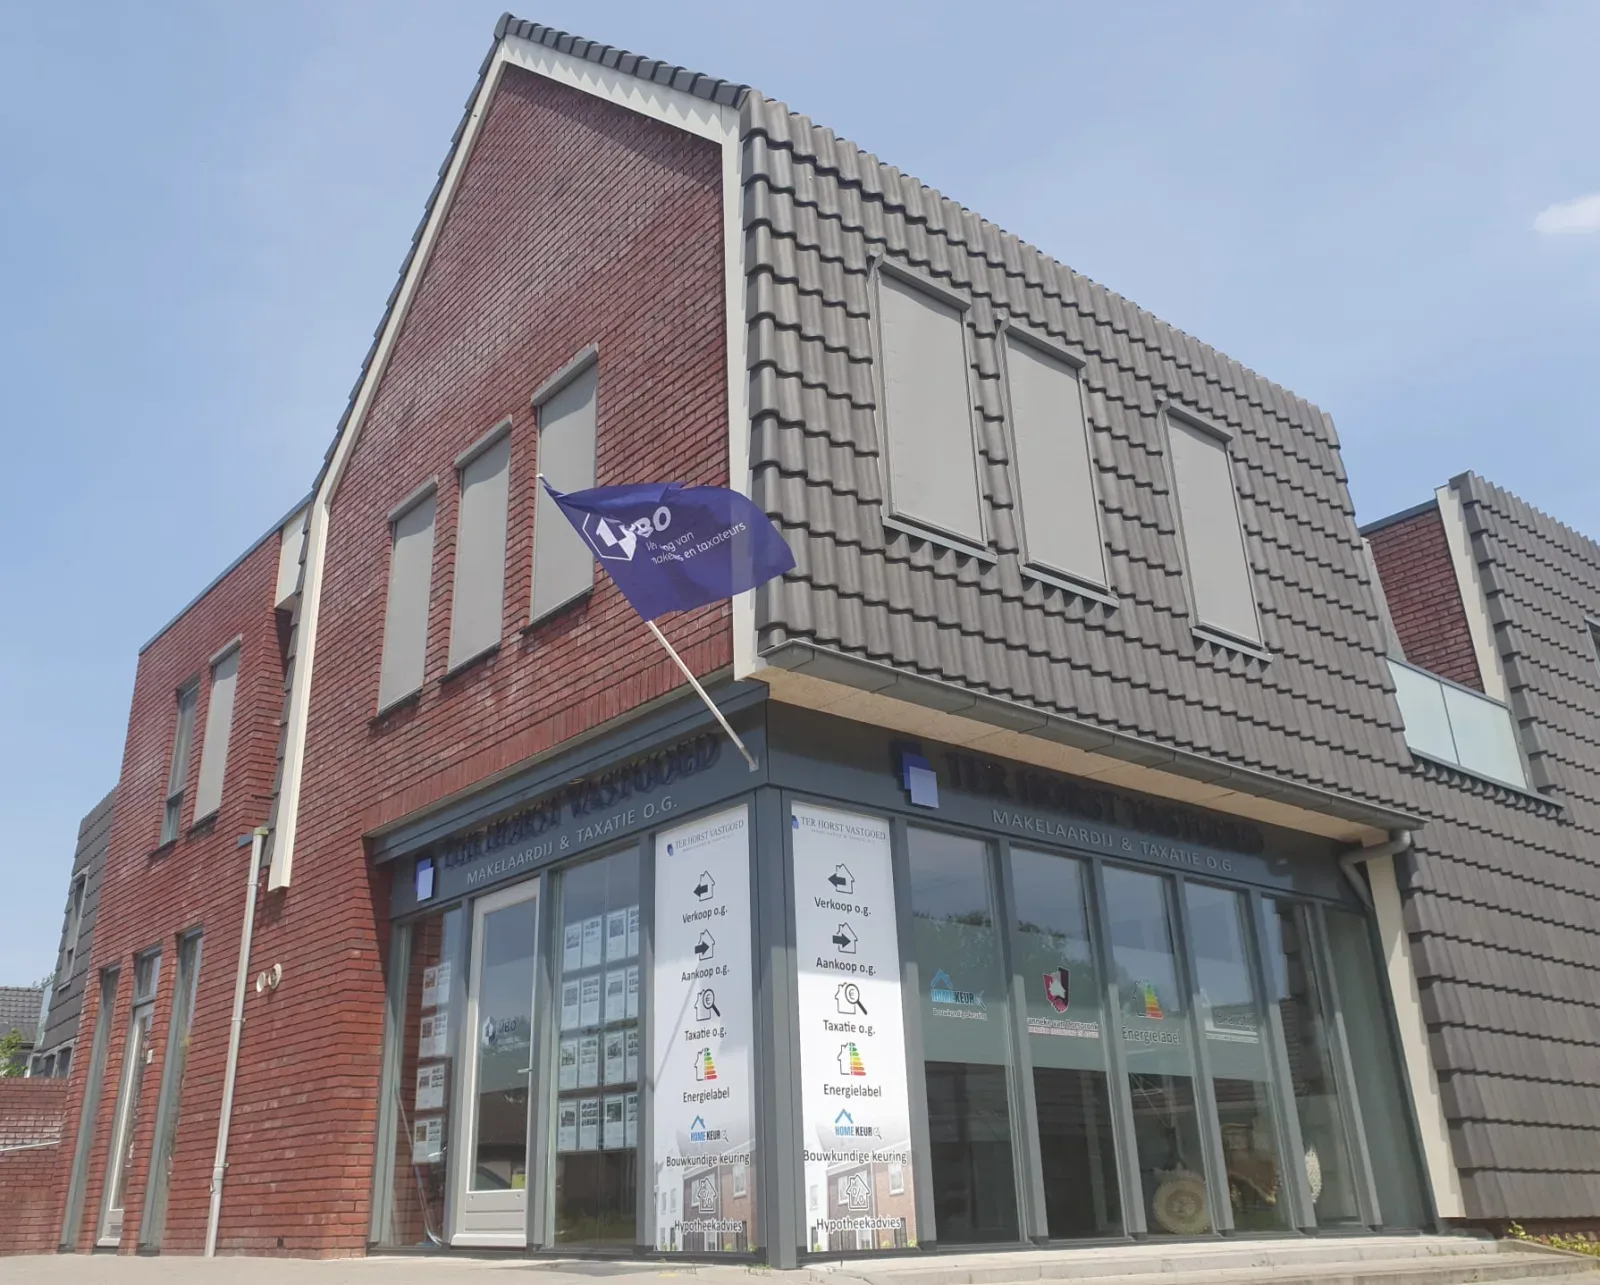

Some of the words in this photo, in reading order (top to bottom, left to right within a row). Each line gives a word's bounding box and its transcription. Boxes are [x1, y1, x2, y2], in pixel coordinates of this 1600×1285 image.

[675, 532, 695, 546] van
[684, 547, 698, 559] en
[696, 522, 746, 552] taxateurs
[688, 831, 709, 846] HORST
[710, 819, 745, 838] VASTGOED
[801, 816, 816, 827] TER
[818, 820, 844, 833] HORST
[845, 825, 886, 840] VASTGOED
[467, 841, 553, 886] MAKELAARDIJ
[559, 835, 571, 850] &
[576, 809, 636, 843] TAXATIE
[643, 796, 678, 818] O.G.
[992, 809, 1113, 847] MAKELAARDIJ
[1121, 837, 1132, 851] &
[1140, 841, 1200, 865] TAXATIE
[1205, 857, 1237, 873] O.G.
[682, 908, 712, 924] Verkoop
[714, 905, 728, 917] o.g.
[814, 896, 853, 914] Verkoop
[854, 905, 872, 917] o.g.
[681, 968, 714, 982] Aankoop
[715, 965, 730, 976] o.g.
[816, 957, 857, 973] Aankoop
[859, 965, 876, 976] o.g.
[954, 991, 976, 1005] KEUR
[684, 1029, 710, 1041] Taxatie
[712, 1027, 727, 1038] o.g.
[823, 1019, 856, 1033] Taxatie
[858, 1025, 876, 1037] o.g.
[1122, 1025, 1181, 1044] Energielabel
[683, 1087, 730, 1104] Energielabel
[823, 1084, 882, 1099] Energielabel
[706, 1130, 721, 1141] KEUR
[835, 1126, 854, 1136] HOME
[855, 1126, 873, 1137] KEUR
[666, 1153, 718, 1167] Bouwkundige
[720, 1152, 750, 1166] keuring
[803, 1149, 870, 1164] Bouwkundige
[872, 1150, 907, 1164] keuring
[674, 1218, 742, 1235] Hypotheekadvies
[816, 1216, 901, 1234] Hypotheekadvies
